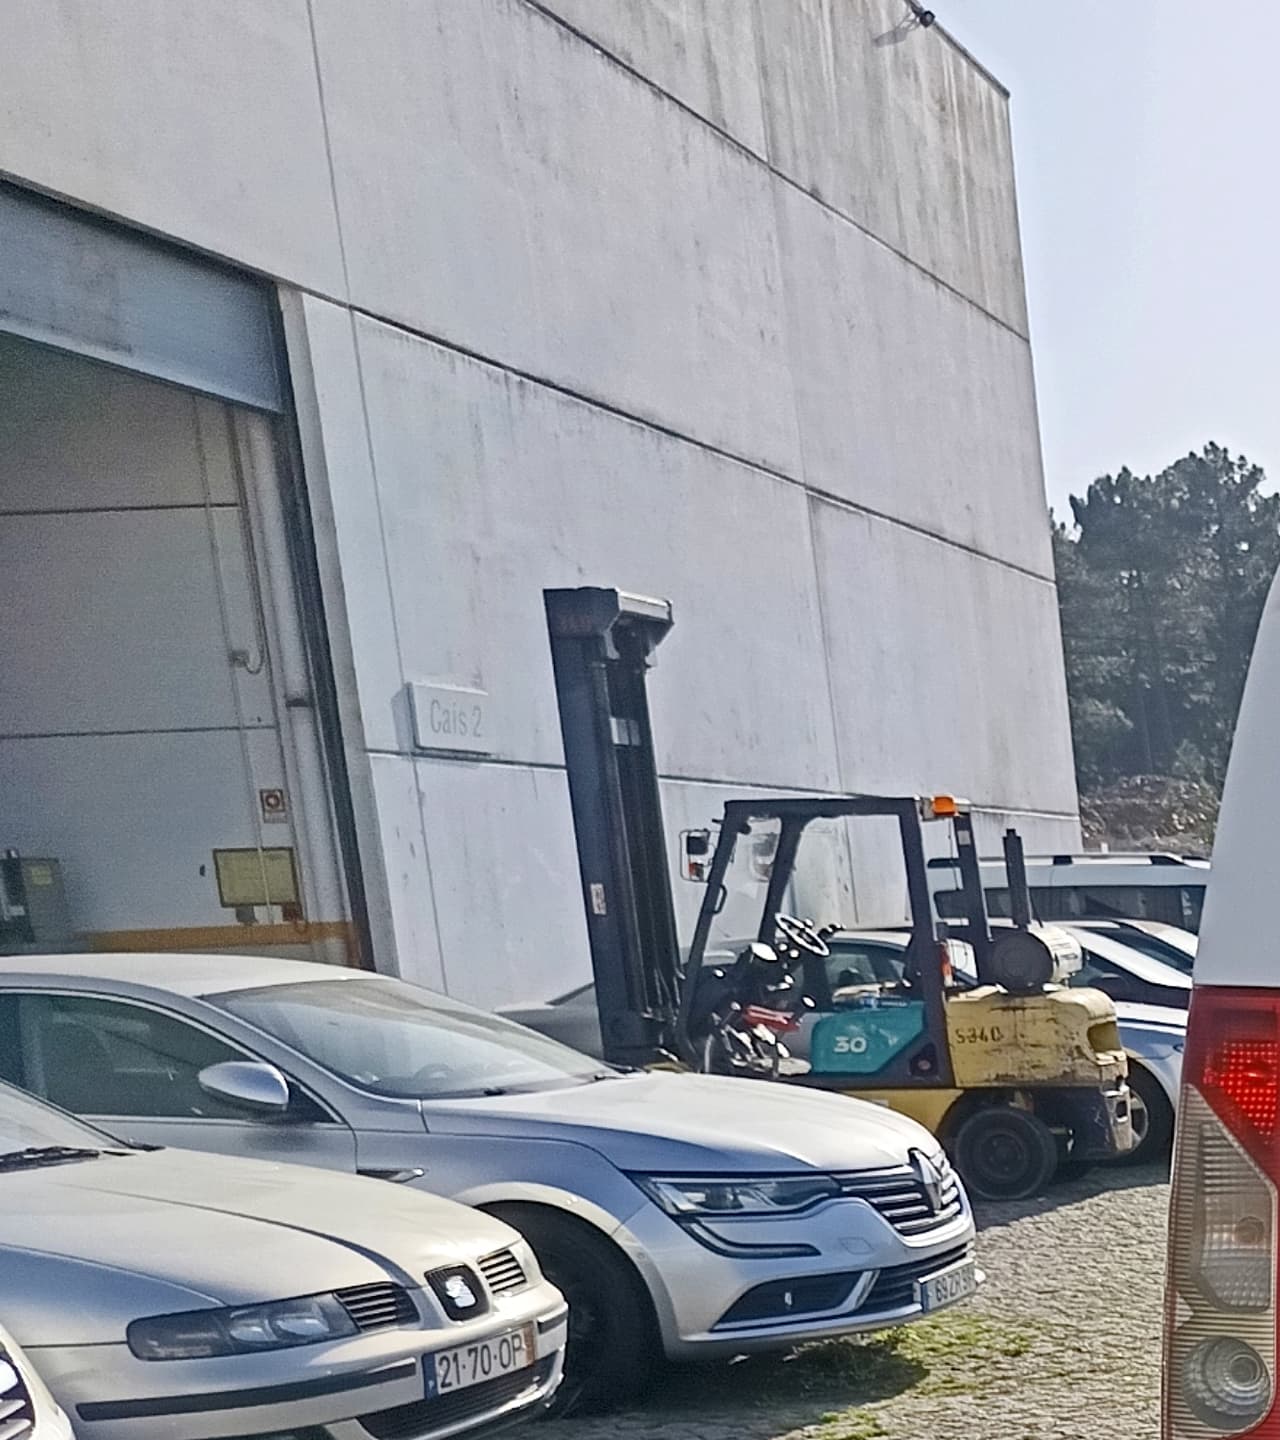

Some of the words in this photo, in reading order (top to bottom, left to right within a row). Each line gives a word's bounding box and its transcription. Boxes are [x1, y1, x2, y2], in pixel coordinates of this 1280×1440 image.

[430, 699, 468, 736] Cais
[472, 704, 483, 738] 2
[834, 1036, 867, 1053] 30
